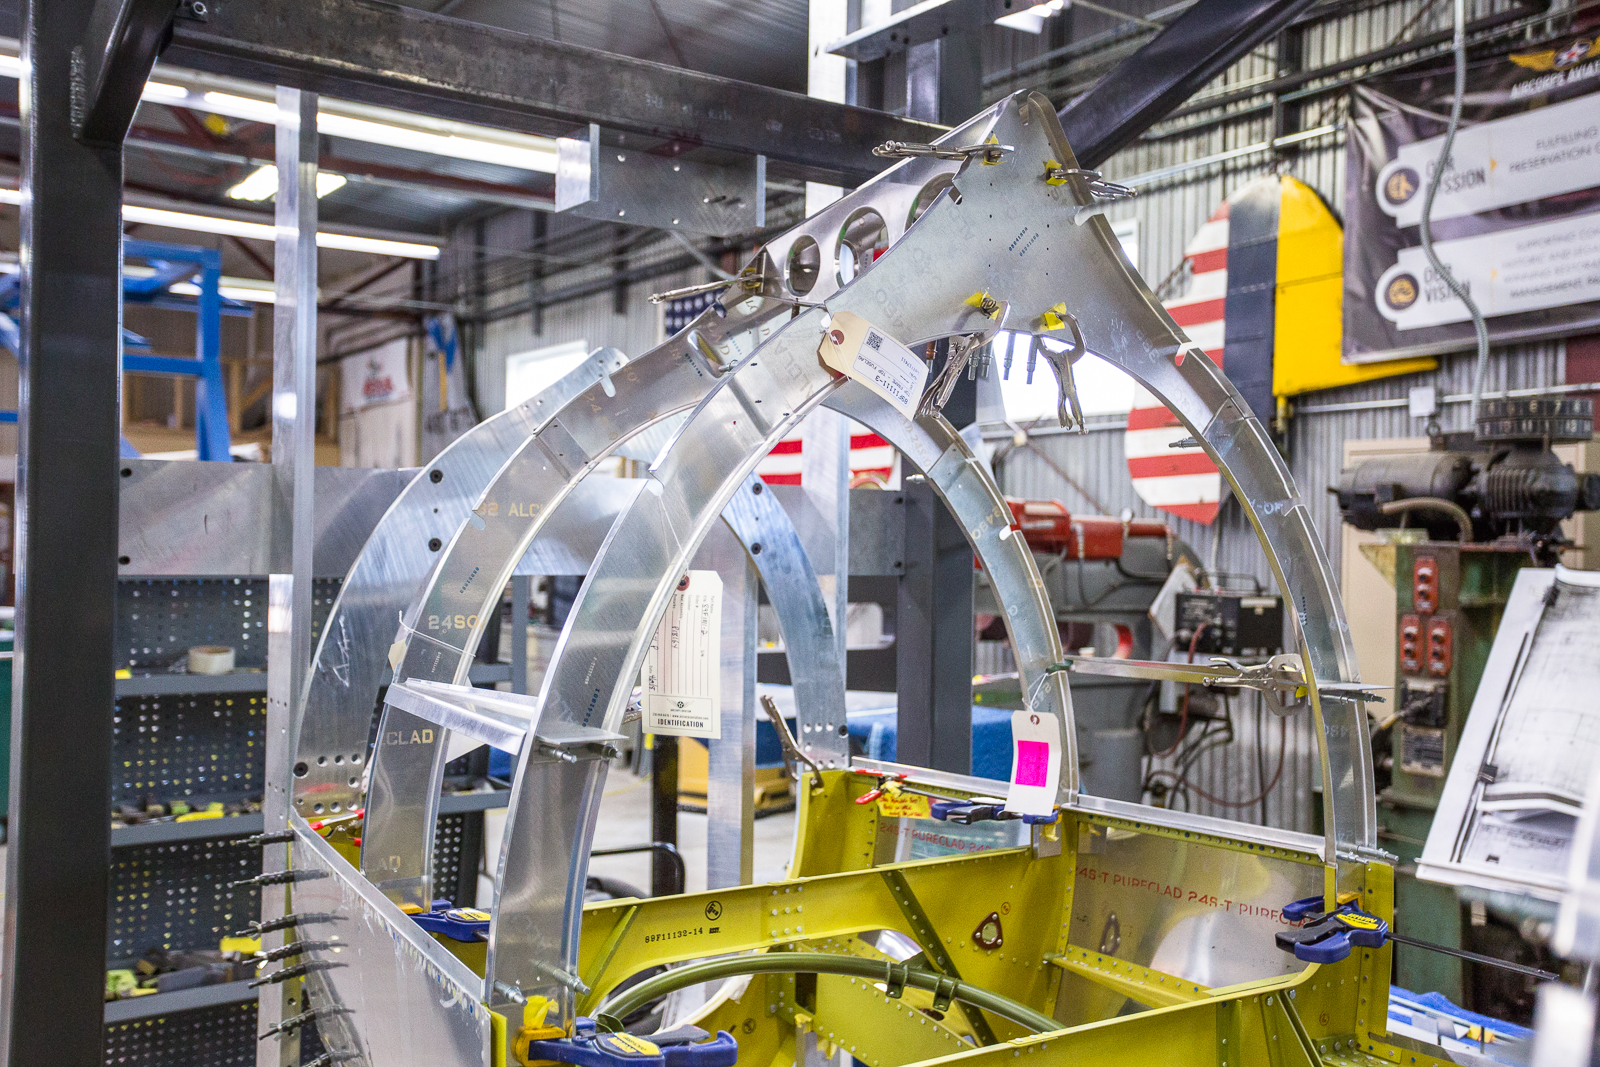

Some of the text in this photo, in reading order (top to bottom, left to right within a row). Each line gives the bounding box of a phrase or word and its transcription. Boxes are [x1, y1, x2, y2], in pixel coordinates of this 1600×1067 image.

[1566, 58, 1600, 82] AVIAT
[1425, 157, 1454, 178] OR
[657, 718, 704, 728] IDENTIFICATION
[911, 829, 966, 852] PURECLAD
[645, 927, 703, 944] 89F11132-14
